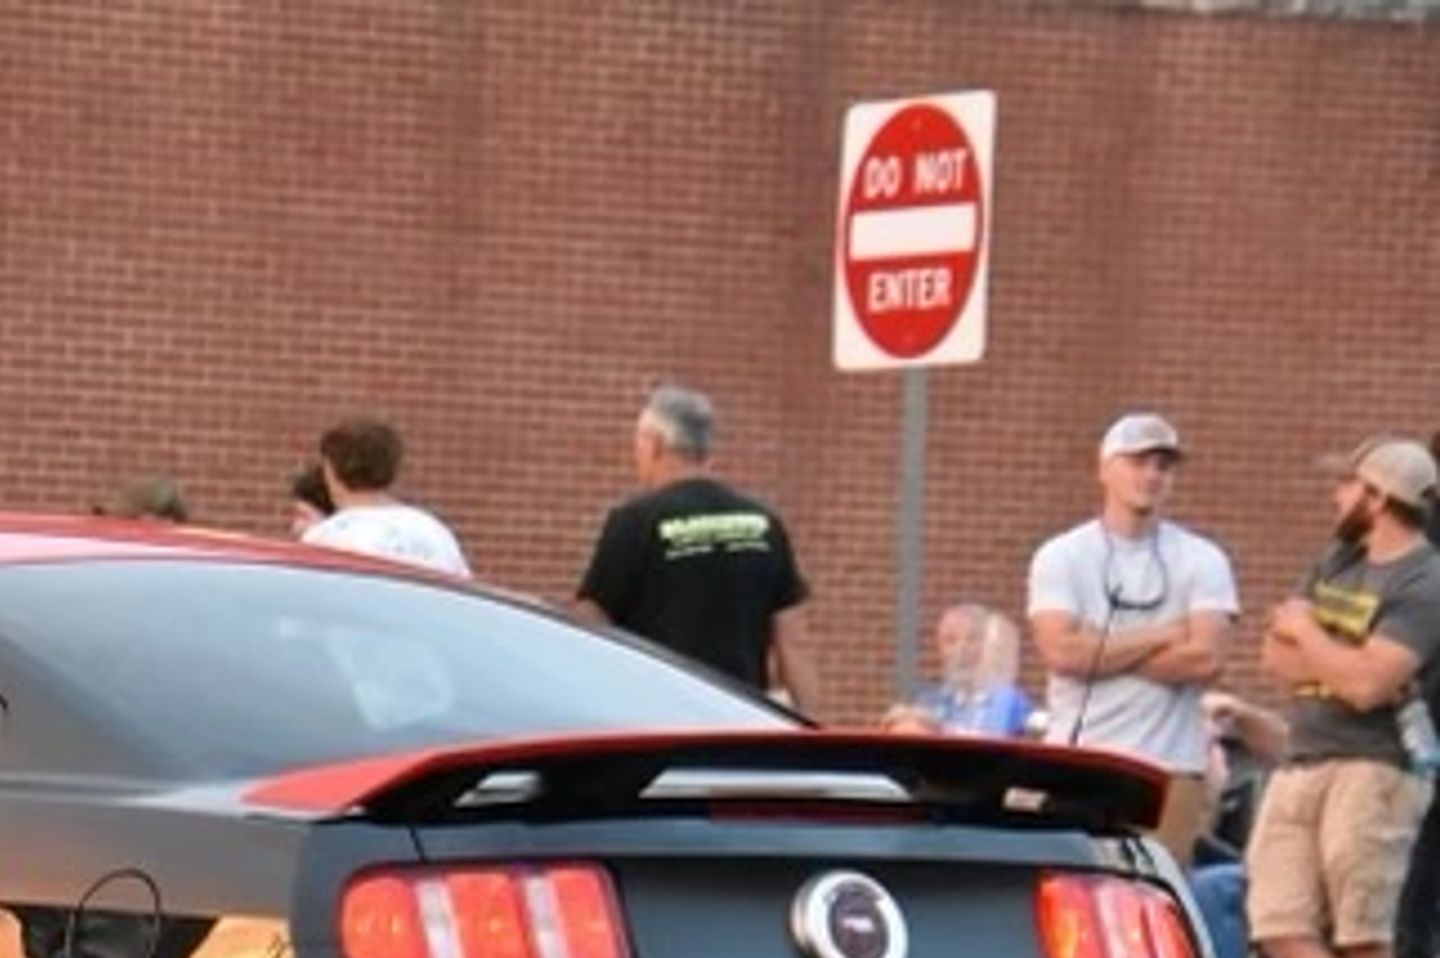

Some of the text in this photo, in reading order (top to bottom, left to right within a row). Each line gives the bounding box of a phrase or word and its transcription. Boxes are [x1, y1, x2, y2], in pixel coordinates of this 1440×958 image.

[863, 148, 968, 198] DO NOT
[867, 266, 953, 314] ENTER
